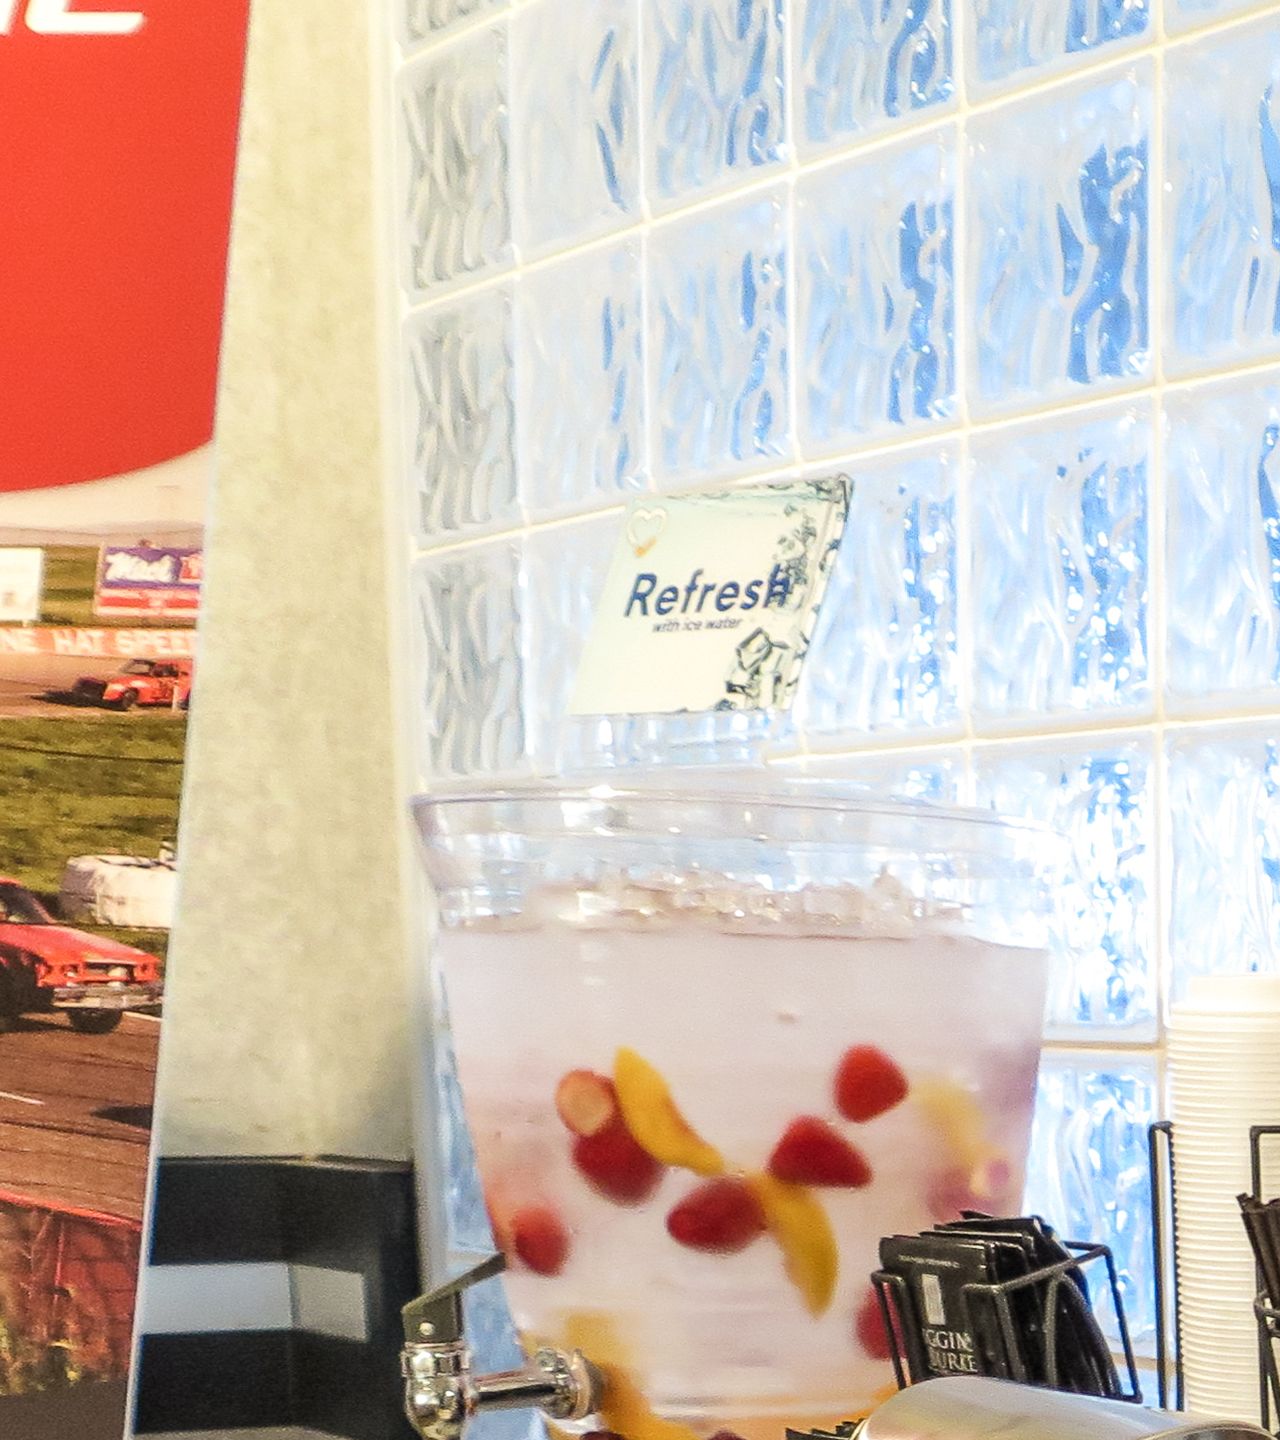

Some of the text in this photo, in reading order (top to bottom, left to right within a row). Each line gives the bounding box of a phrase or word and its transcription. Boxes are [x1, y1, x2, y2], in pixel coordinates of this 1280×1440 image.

[623, 562, 791, 618] Refresh
[652, 616, 744, 633] with ice water
